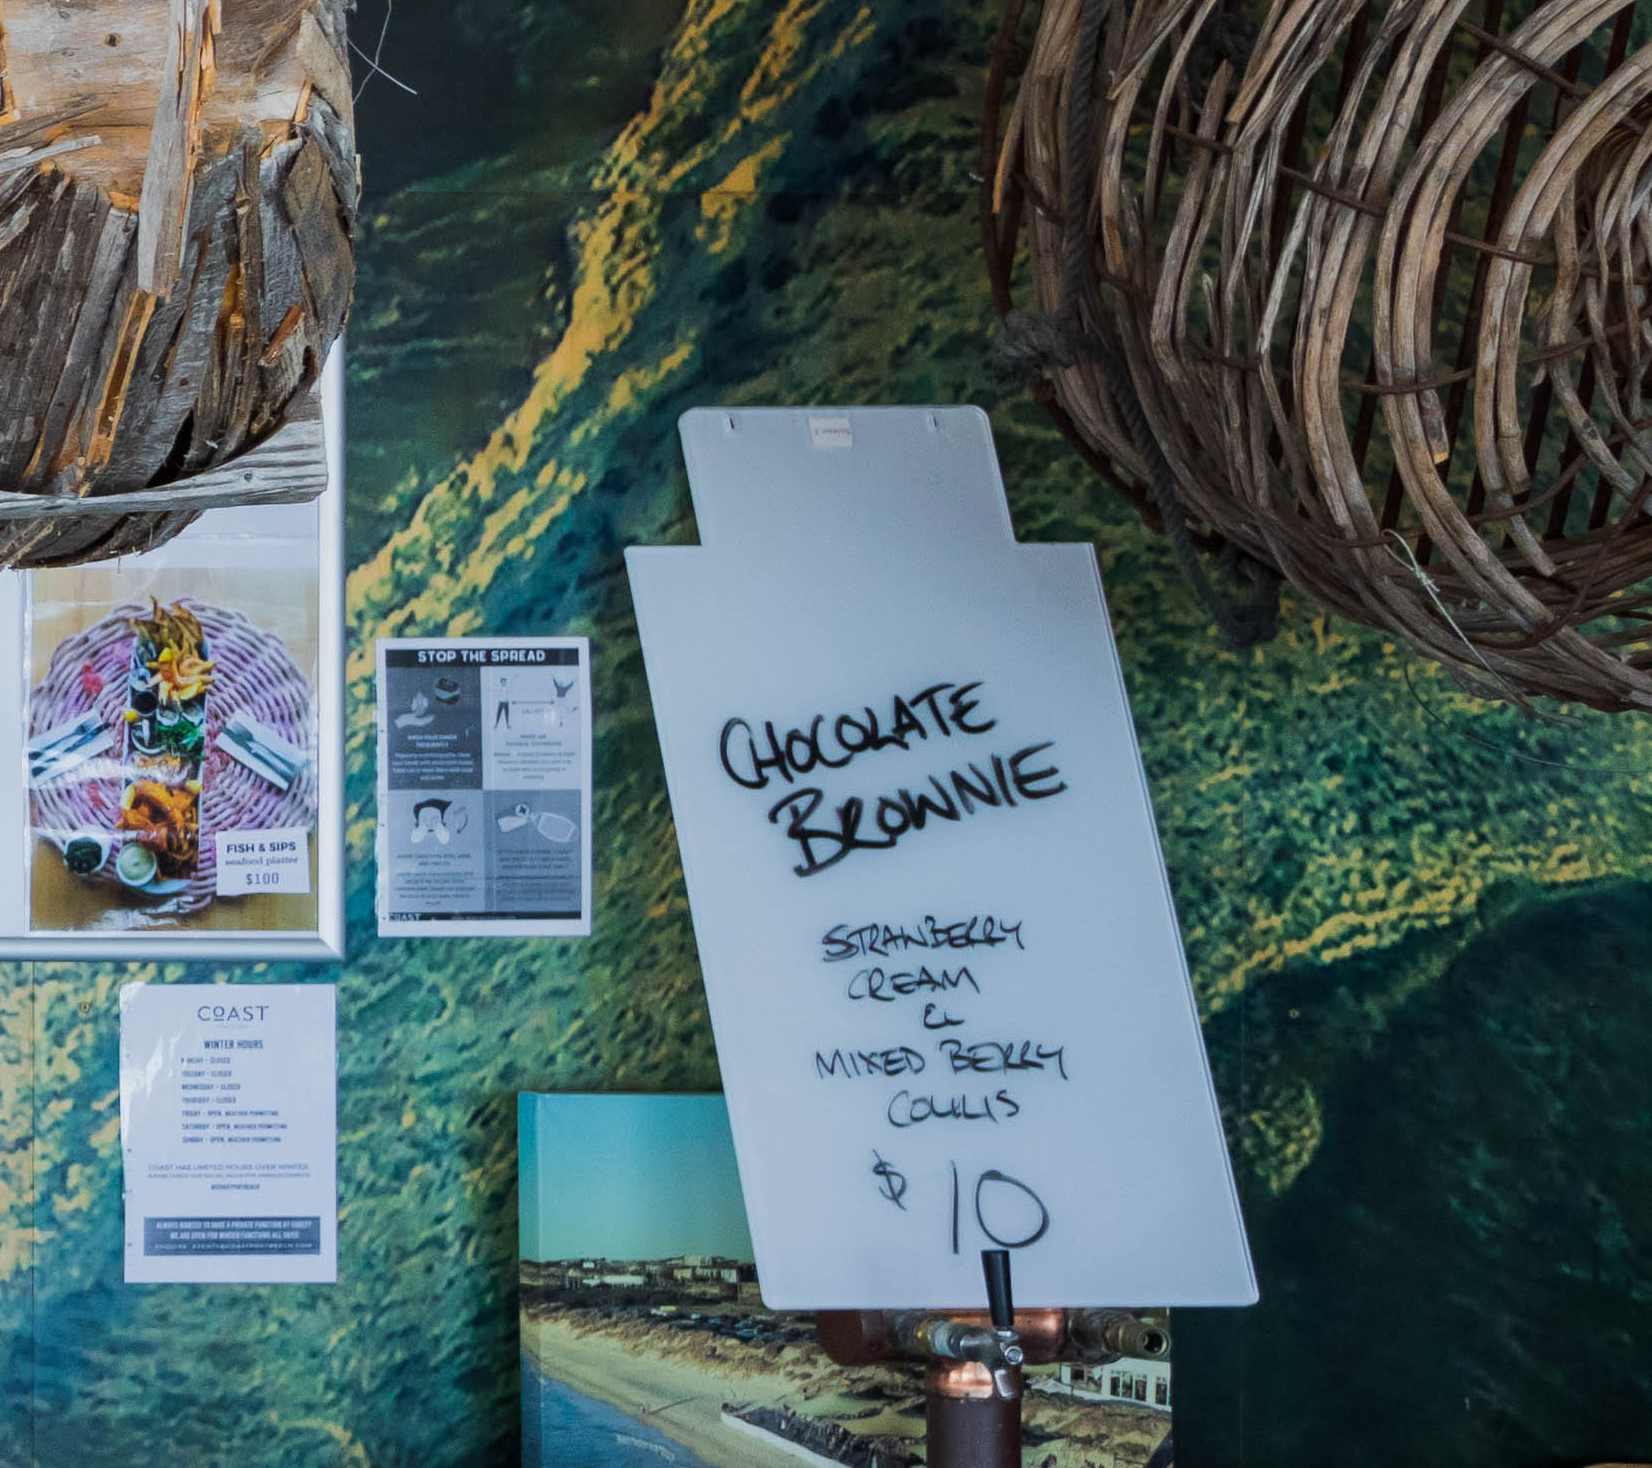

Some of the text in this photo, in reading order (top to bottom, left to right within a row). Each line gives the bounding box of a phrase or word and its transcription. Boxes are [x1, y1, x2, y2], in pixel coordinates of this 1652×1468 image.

[418, 649, 546, 663] STOP THE SPREAD
[719, 680, 999, 791] CHOCOLATE
[768, 739, 1067, 877] BROWNIE
[227, 842, 296, 853] FISH & SIPS
[246, 872, 279, 886] $100
[822, 915, 1024, 961] STRAWBERRY
[847, 968, 982, 1001] CREAM
[197, 1005, 270, 1022] COAST
[204, 1039, 264, 1050] WINTER HOURS
[813, 1039, 1067, 1081] MIXED BERRY
[887, 1090, 1020, 1126] COULIS
[872, 1150, 1049, 1254] $ 10
